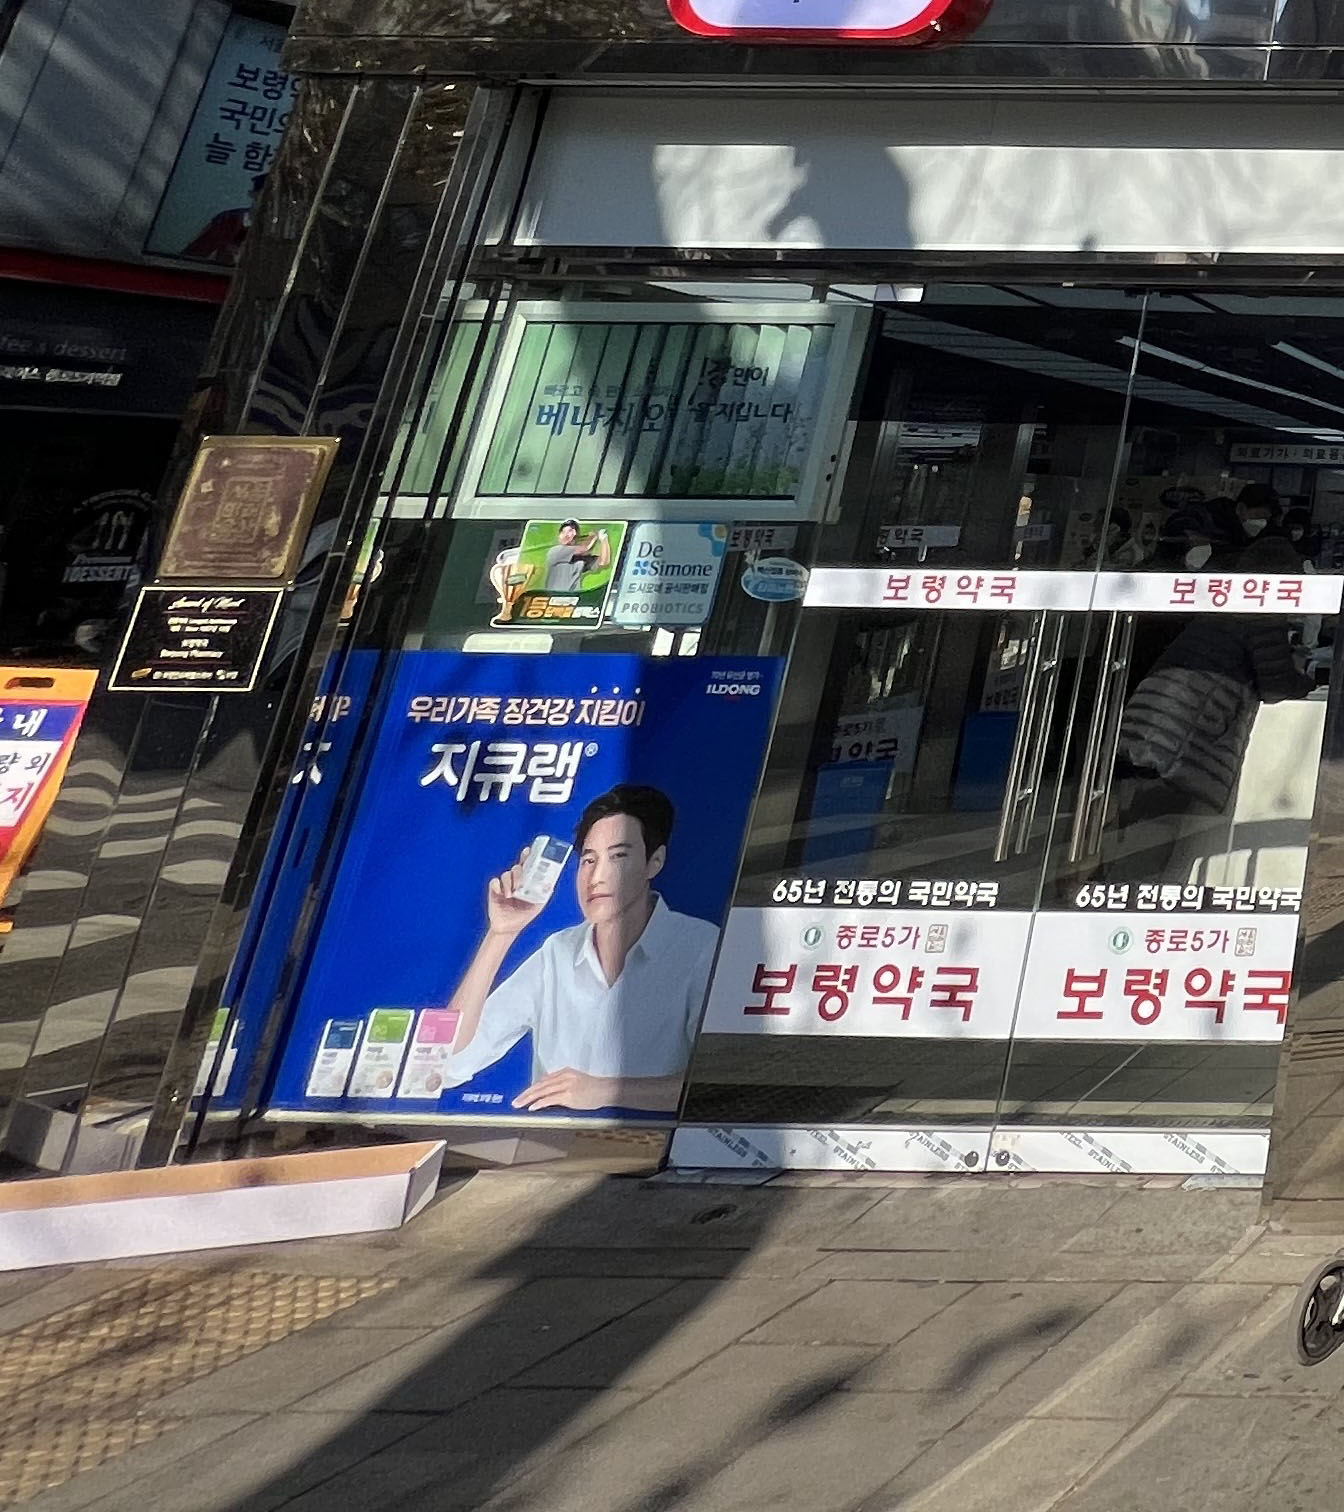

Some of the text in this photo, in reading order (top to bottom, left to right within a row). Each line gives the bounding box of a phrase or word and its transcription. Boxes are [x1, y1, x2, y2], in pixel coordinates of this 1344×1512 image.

[637, 541, 664, 558] De
[647, 560, 713, 577] Simone
[882, 573, 1018, 606] 보령약국
[1169, 576, 1304, 609] 보령약국
[621, 603, 704, 614] PROBIOTICS
[705, 683, 761, 696] ILDONG
[0, 705, 48, 738] 내
[406, 696, 644, 728] 우리가족 장건강 지킴이
[771, 878, 828, 904] 65년
[906, 880, 1000, 909] 국민약국
[1075, 884, 1130, 909] 65년
[1211, 885, 1302, 913] 국민약국
[837, 923, 921, 951] 종로5가
[1144, 927, 1230, 954] 종로5가
[743, 963, 980, 1022] 보령약국
[1057, 967, 1293, 1025] 보령약국
